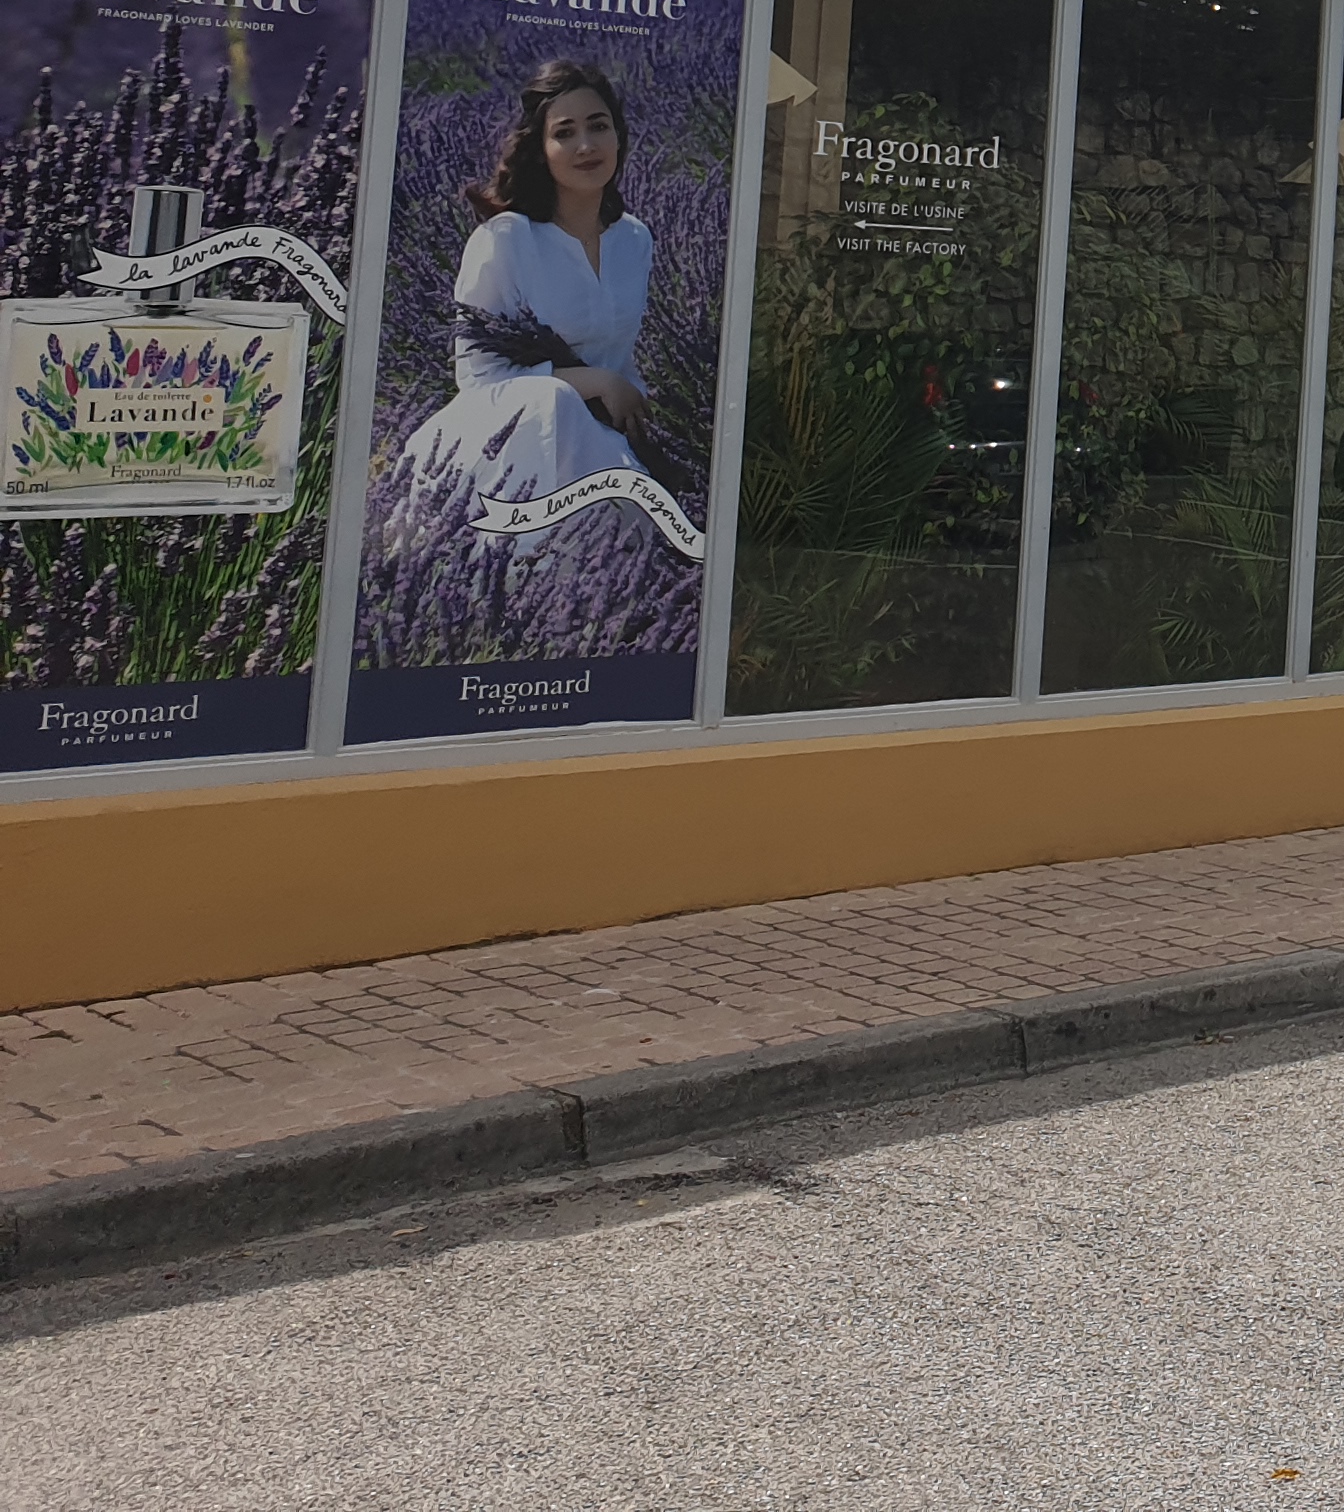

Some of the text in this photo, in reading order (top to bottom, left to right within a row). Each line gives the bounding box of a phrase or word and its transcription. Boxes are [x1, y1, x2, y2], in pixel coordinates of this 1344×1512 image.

[97, 7, 275, 32] FRAGONARD LOVES LAVENDER
[506, 13, 650, 36] FRAGONARD LOVES LAVENDER
[813, 120, 1001, 172] Fragonard
[841, 171, 972, 190] PARFUMEUR
[844, 200, 965, 219] VISITE DE L'USINE
[837, 237, 967, 256] VISIT THE FACTORY
[119, 263, 153, 285] la
[167, 231, 262, 277] lavande
[114, 392, 134, 401] Eau
[137, 391, 149, 401] de
[86, 401, 215, 424] Lavande
[110, 464, 182, 481] Fragonard
[7, 480, 49, 495] 50 ml
[503, 474, 697, 547] la lavande Fragonard
[458, 670, 591, 705] Fragonard
[37, 694, 200, 736] Fragonard
[477, 701, 570, 716] PARFUMEUR
[61, 731, 174, 746] PARFUMEUR
